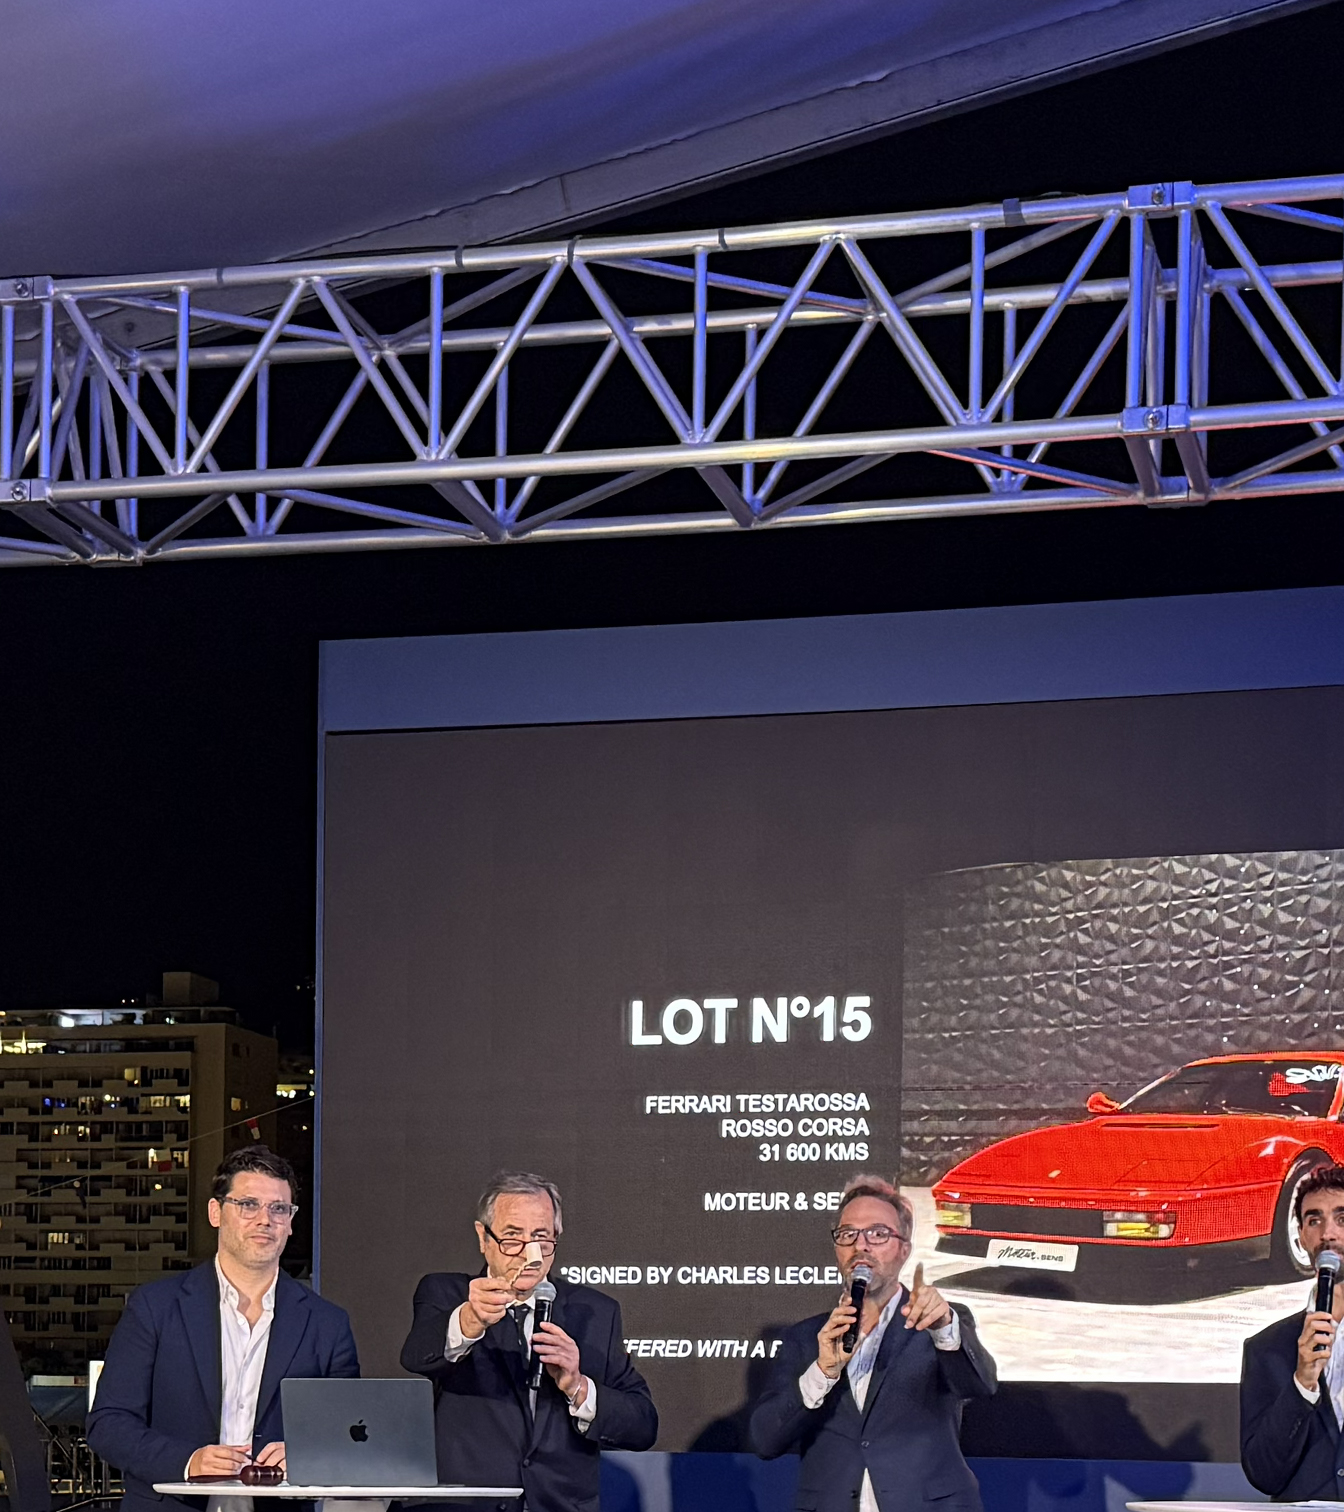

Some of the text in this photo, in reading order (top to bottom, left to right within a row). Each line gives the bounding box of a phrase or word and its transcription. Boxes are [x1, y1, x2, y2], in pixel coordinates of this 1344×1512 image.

[631, 998, 739, 1046] LOT
[645, 1092, 871, 1115] FERRARI TESTAROSSA
[721, 1117, 870, 1138] ROSSO CORSA
[758, 1142, 870, 1162] 31 600 KMS
[703, 1191, 845, 1211] MOTEUR & SE
[646, 1266, 673, 1285] BY
[676, 1265, 770, 1284] CHARLES
[697, 1339, 748, 1358] WITH
[750, 1340, 765, 1358] A
